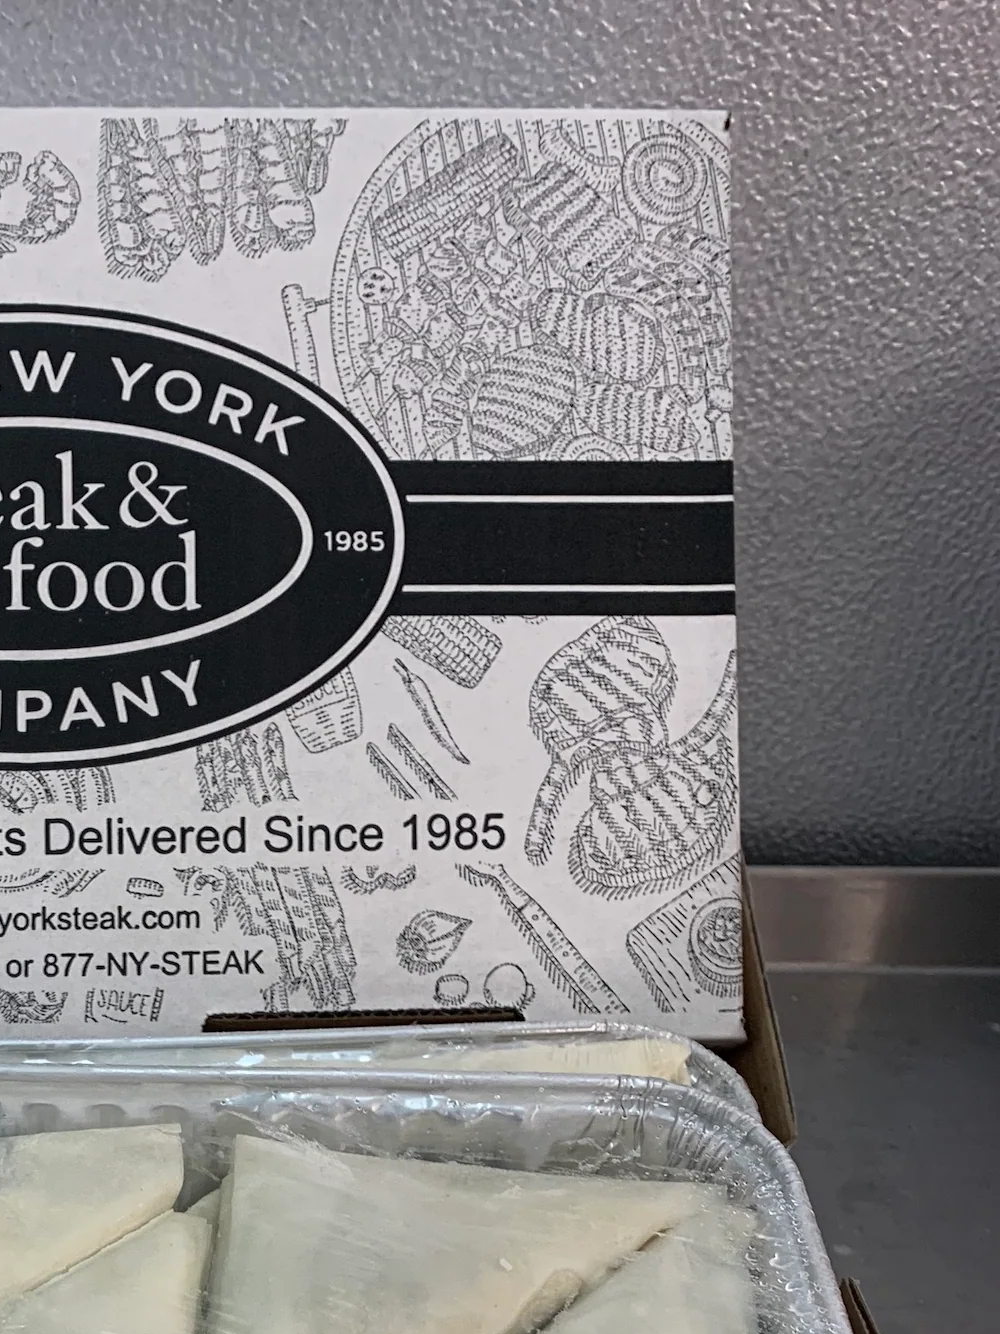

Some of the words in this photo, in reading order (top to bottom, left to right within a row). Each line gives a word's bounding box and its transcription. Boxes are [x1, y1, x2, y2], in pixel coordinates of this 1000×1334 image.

[111, 355, 306, 456] YORK
[119, 461, 189, 529] &
[324, 530, 385, 552] 1985
[44, 816, 246, 856] Delivered
[264, 814, 384, 853] Since
[403, 812, 506, 851] 1985
[6, 959, 34, 978] or
[43, 949, 265, 978] 877-NY-STEAK
[97, 989, 151, 1017] SAUCE
